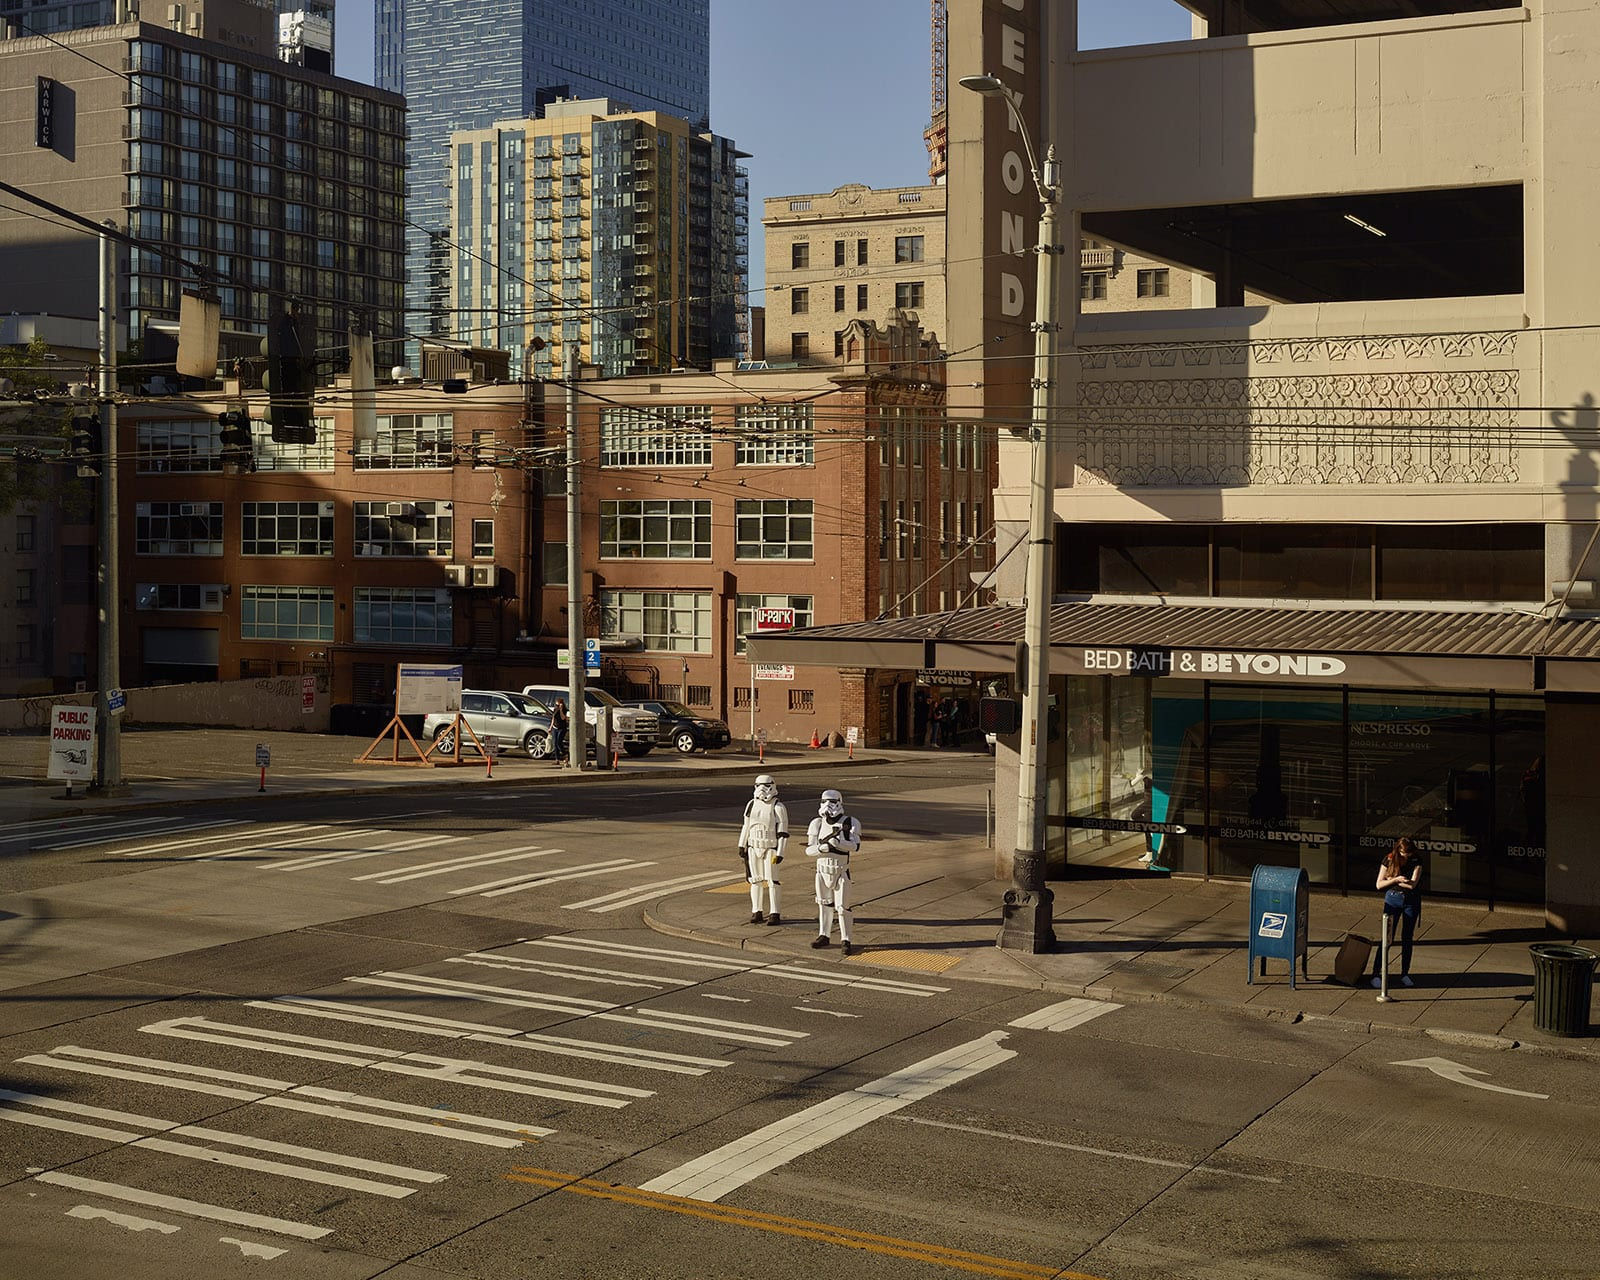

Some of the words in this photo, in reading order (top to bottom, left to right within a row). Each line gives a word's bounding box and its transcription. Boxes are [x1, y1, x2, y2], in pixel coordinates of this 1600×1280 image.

[42, 80, 51, 143] WARWICK
[1002, 0, 1025, 318] EYOND
[588, 651, 595, 662] 2
[1084, 650, 1122, 670] BED
[1126, 651, 1175, 671] BATH
[1180, 652, 1196, 672] &
[1200, 653, 1347, 676] BEYOND
[918, 675, 973, 686] BEYOND
[58, 711, 88, 724] PUBLIC
[54, 728, 91, 741] PARKING
[1351, 723, 1431, 736] NESPRESSO
[1128, 822, 1187, 834] BEYOND
[1220, 827, 1236, 838] BED
[1238, 829, 1258, 839] BATH
[1259, 831, 1266, 840] &
[1267, 832, 1330, 843] BEYOND
[1359, 836, 1376, 847] BED
[1507, 846, 1526, 857] BED
